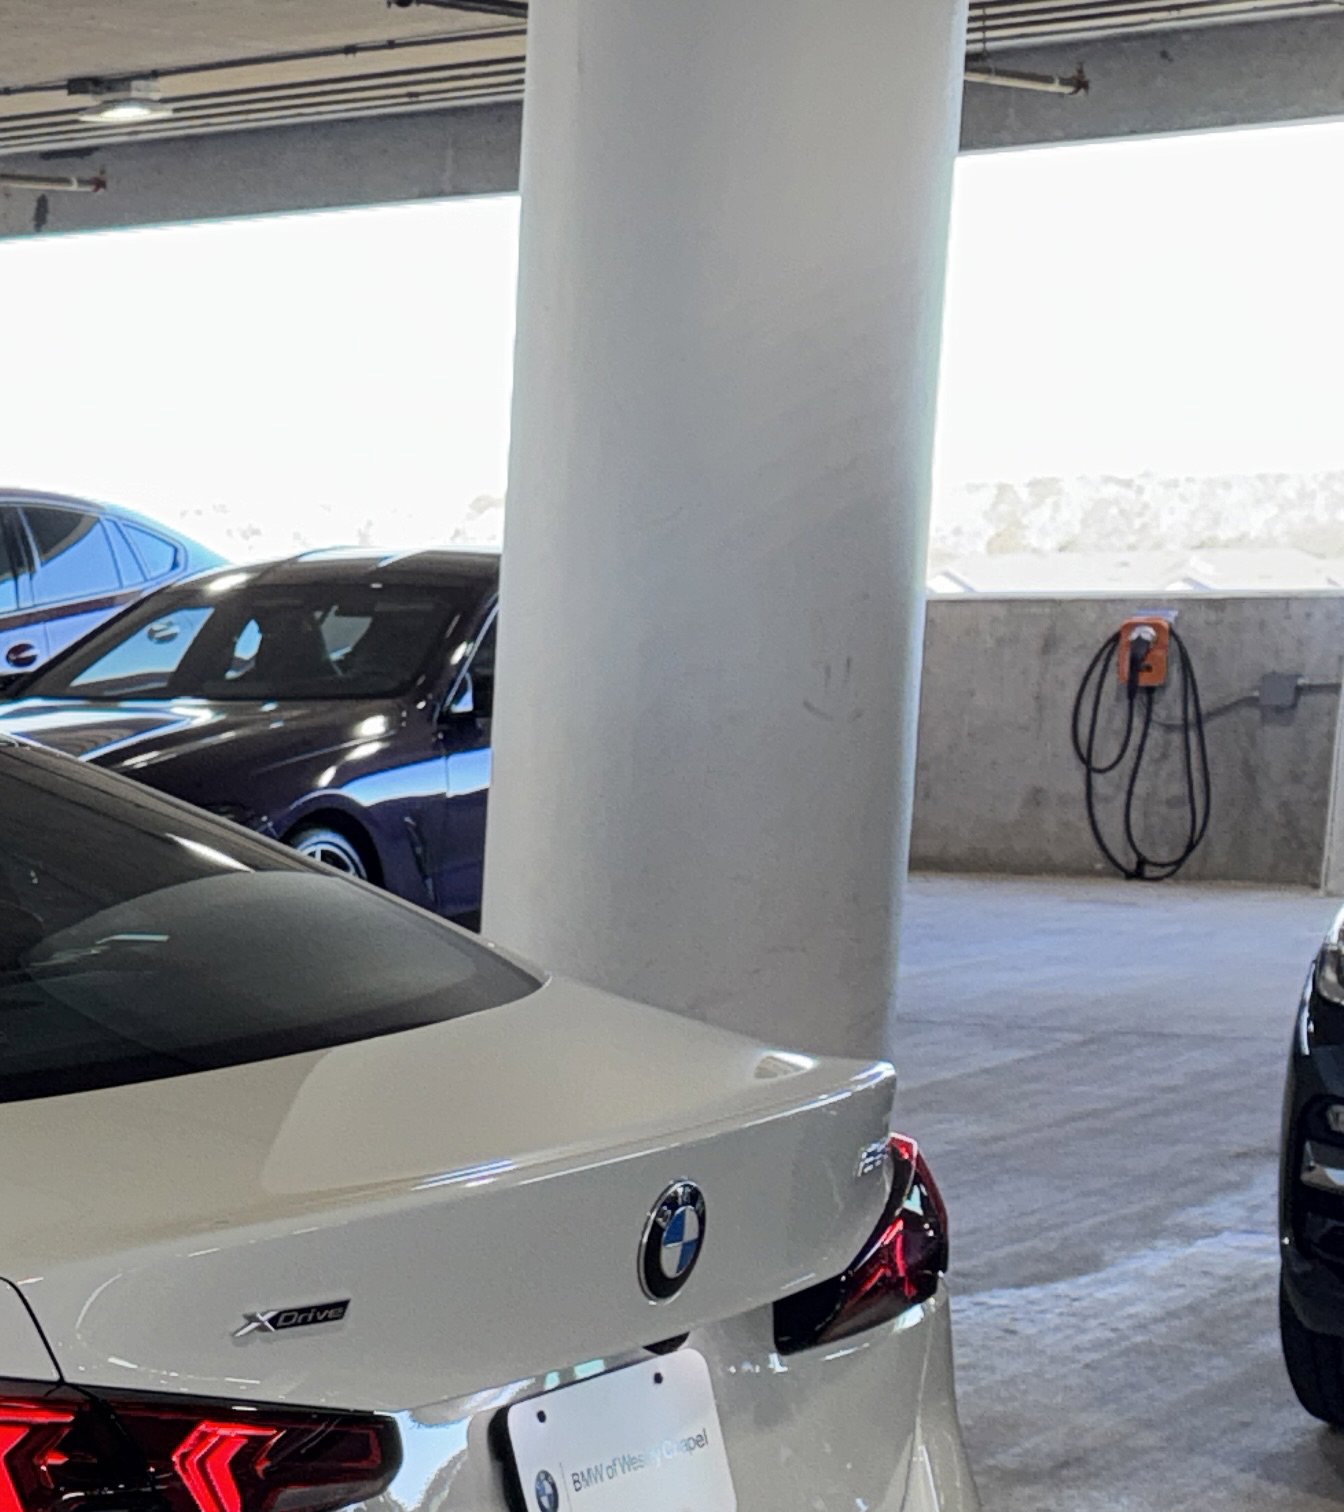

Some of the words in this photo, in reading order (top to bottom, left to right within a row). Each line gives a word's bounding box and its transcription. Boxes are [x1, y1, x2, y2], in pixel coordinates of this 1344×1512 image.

[571, 1464, 605, 1493] BMW
[606, 1457, 618, 1480] of
[662, 1428, 710, 1460] Capel
